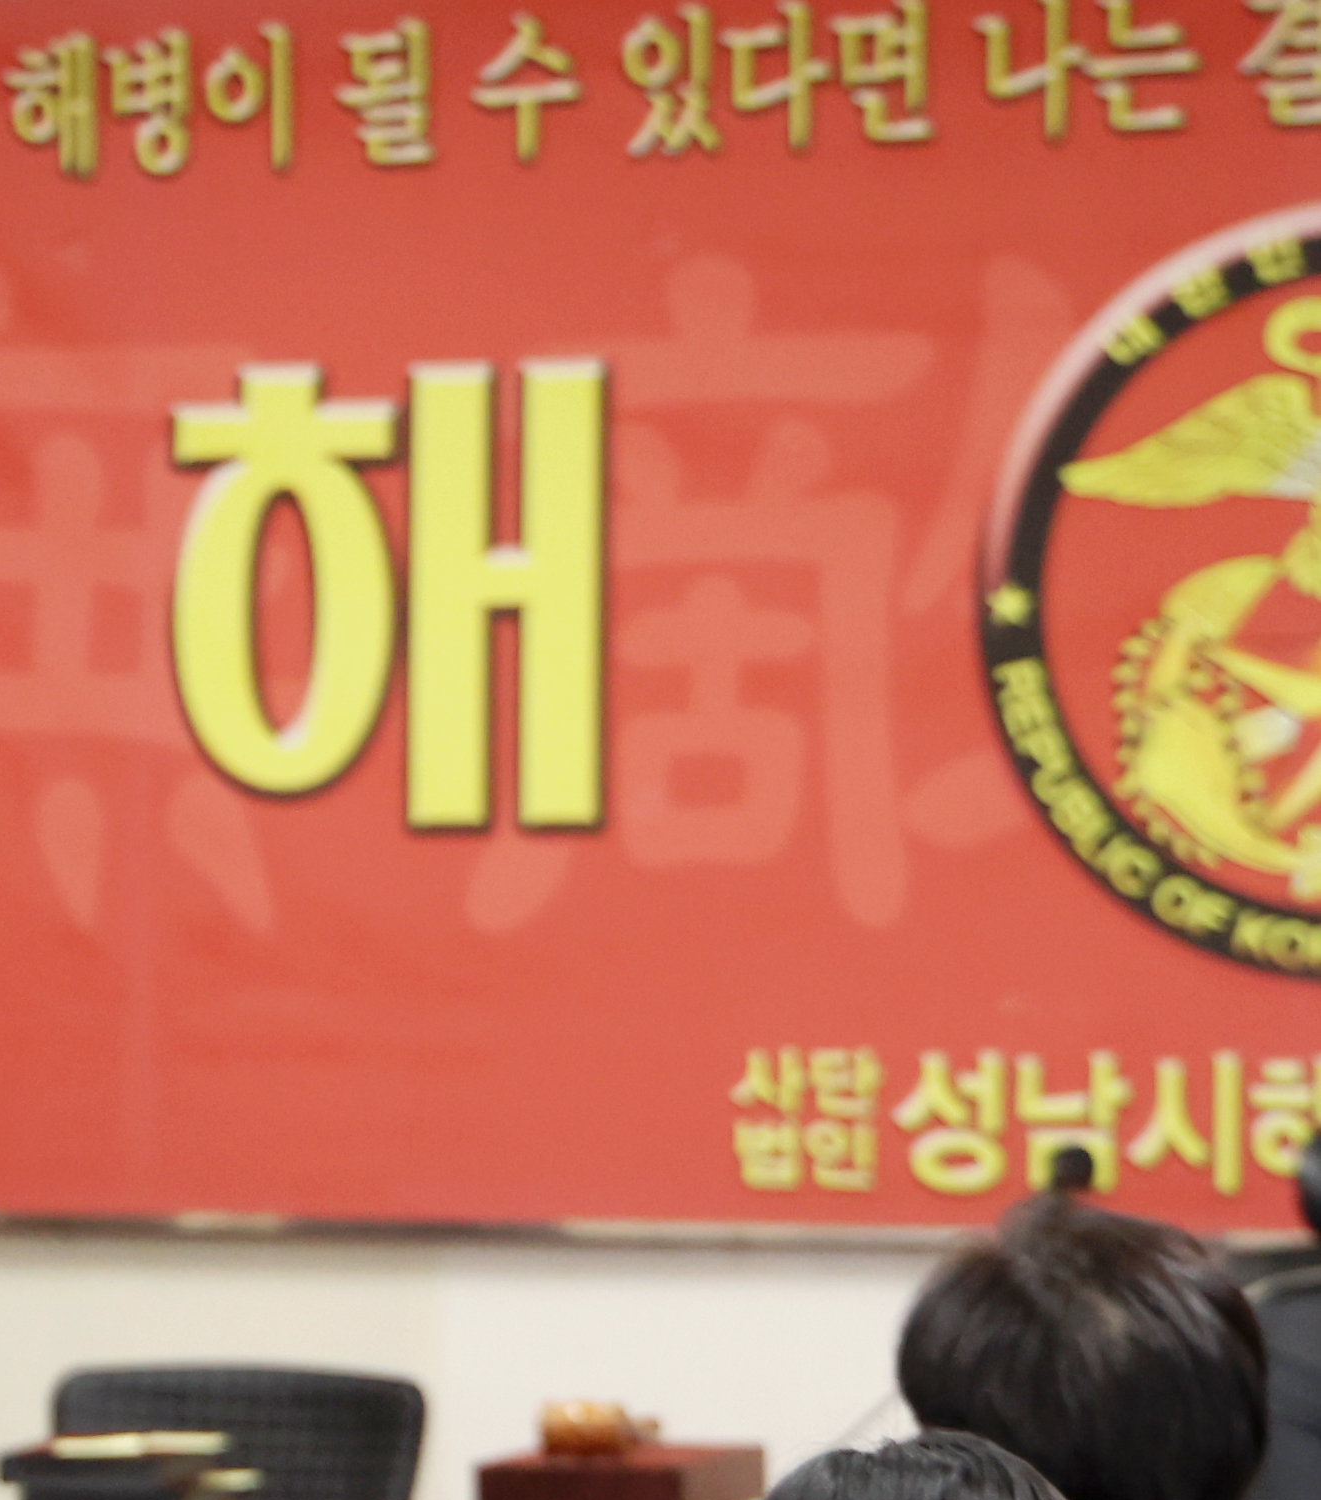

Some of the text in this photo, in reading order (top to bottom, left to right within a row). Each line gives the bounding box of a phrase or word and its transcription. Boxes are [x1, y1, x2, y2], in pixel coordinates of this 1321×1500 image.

[3, 22, 294, 177] 해병이
[335, 16, 434, 166] 될
[470, 14, 582, 163] 수
[620, 4, 936, 154] 있다면
[974, 0, 1201, 143] 나는
[171, 356, 607, 830] 해
[993, 656, 1160, 898] REPUBLIC
[1150, 874, 1237, 936] OF
[729, 1046, 883, 1118] 사단
[732, 1118, 879, 1192] 법인
